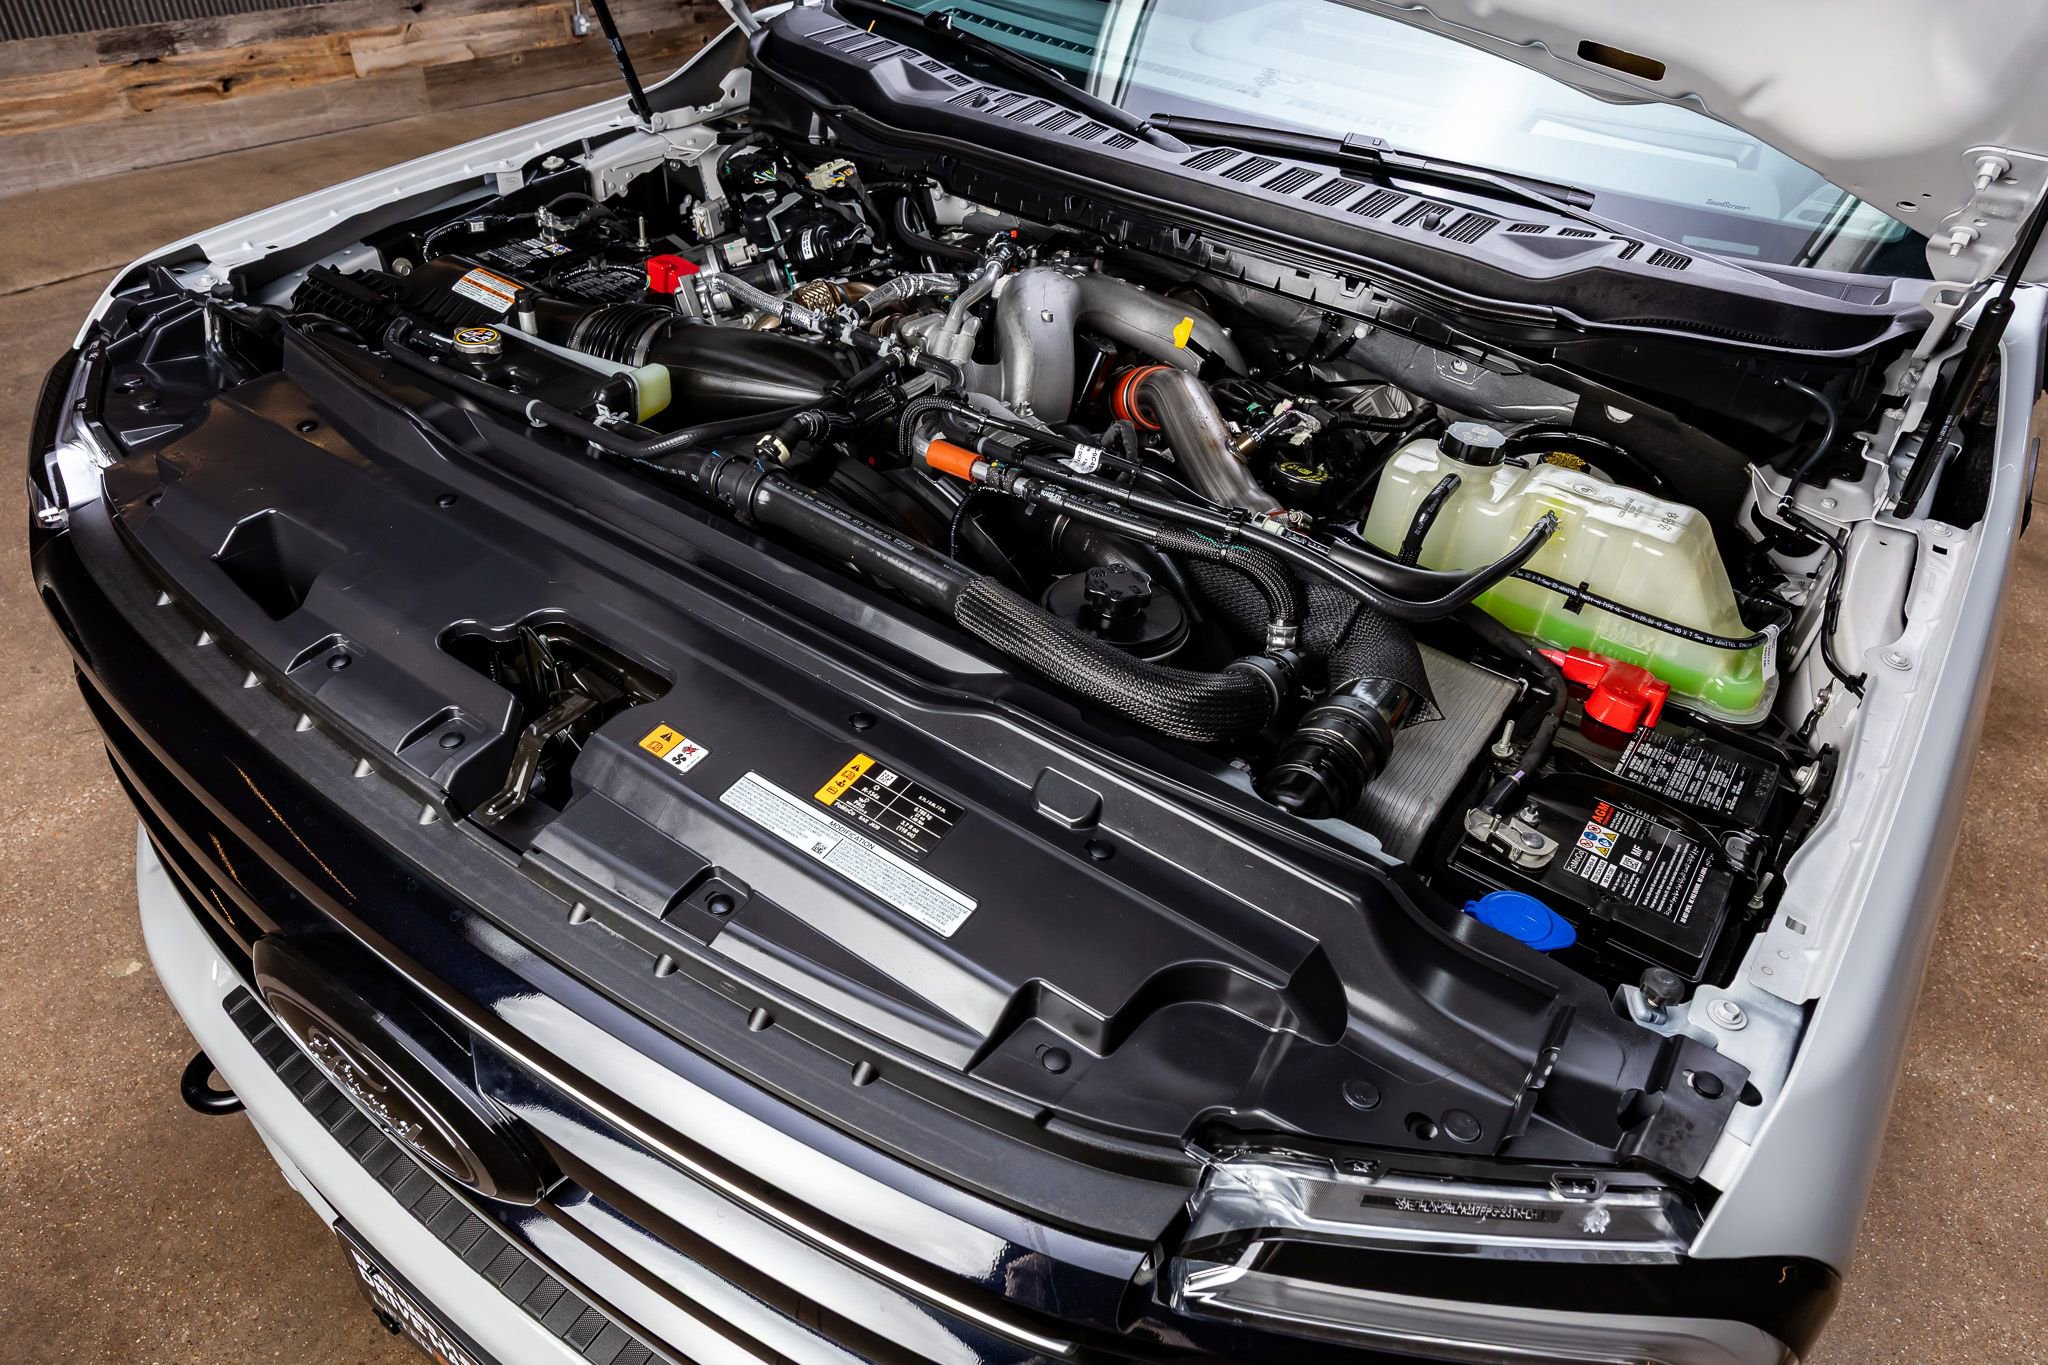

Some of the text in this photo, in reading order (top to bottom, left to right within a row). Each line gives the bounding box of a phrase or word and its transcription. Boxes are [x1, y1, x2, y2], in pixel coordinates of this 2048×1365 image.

[834, 802, 856, 816] FoMoCo
[853, 800, 866, 809] PAG
[1591, 801, 1610, 824] AGM
[828, 821, 875, 850] MODIFICATION
[1567, 848, 1586, 873] FoMoCo
[1630, 844, 1644, 858] MF
[358, 1264, 426, 1338] DRIVE
